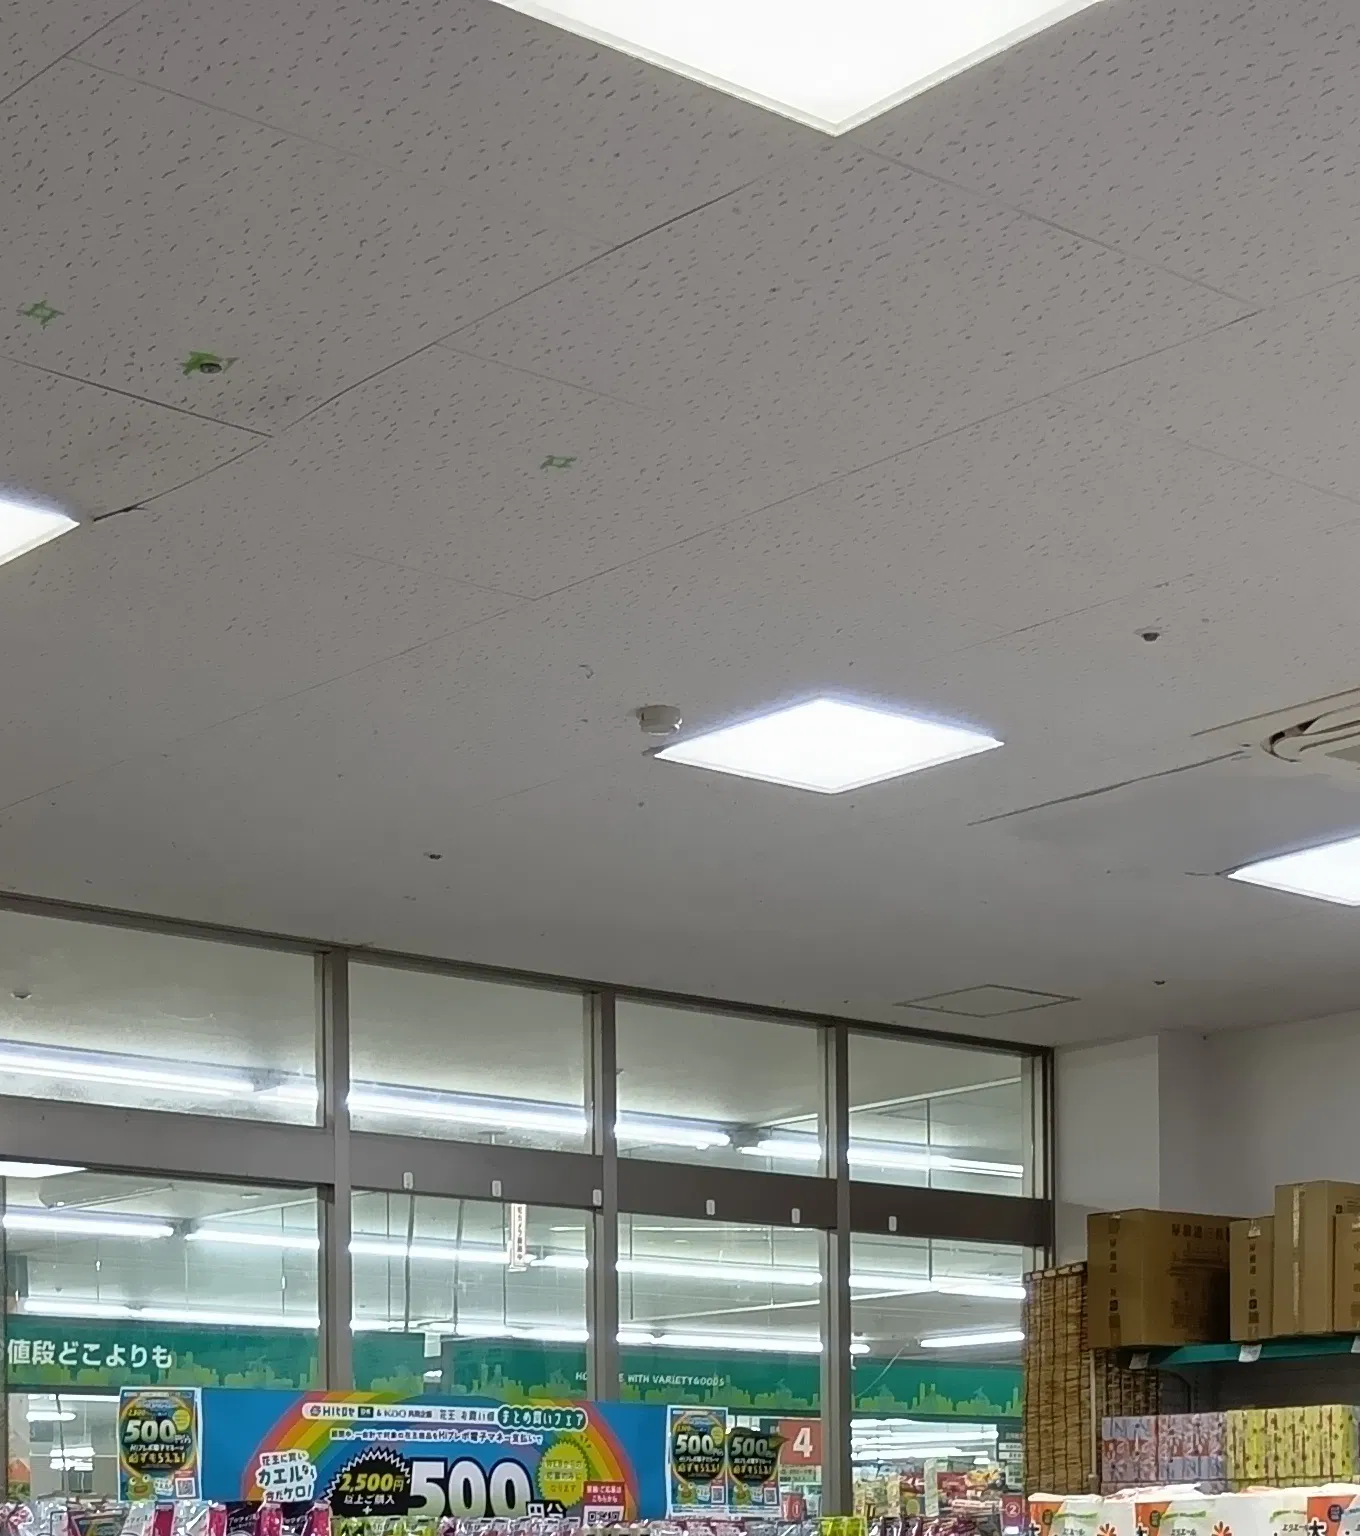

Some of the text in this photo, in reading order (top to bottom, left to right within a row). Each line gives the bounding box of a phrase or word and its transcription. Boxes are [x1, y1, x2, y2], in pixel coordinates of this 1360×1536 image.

[628, 1375, 650, 1383] WITH
[124, 1420, 176, 1443] 500
[792, 1426, 814, 1458] 4
[675, 1434, 714, 1455] 500
[731, 1436, 768, 1454] 500
[411, 1458, 532, 1518] 500
